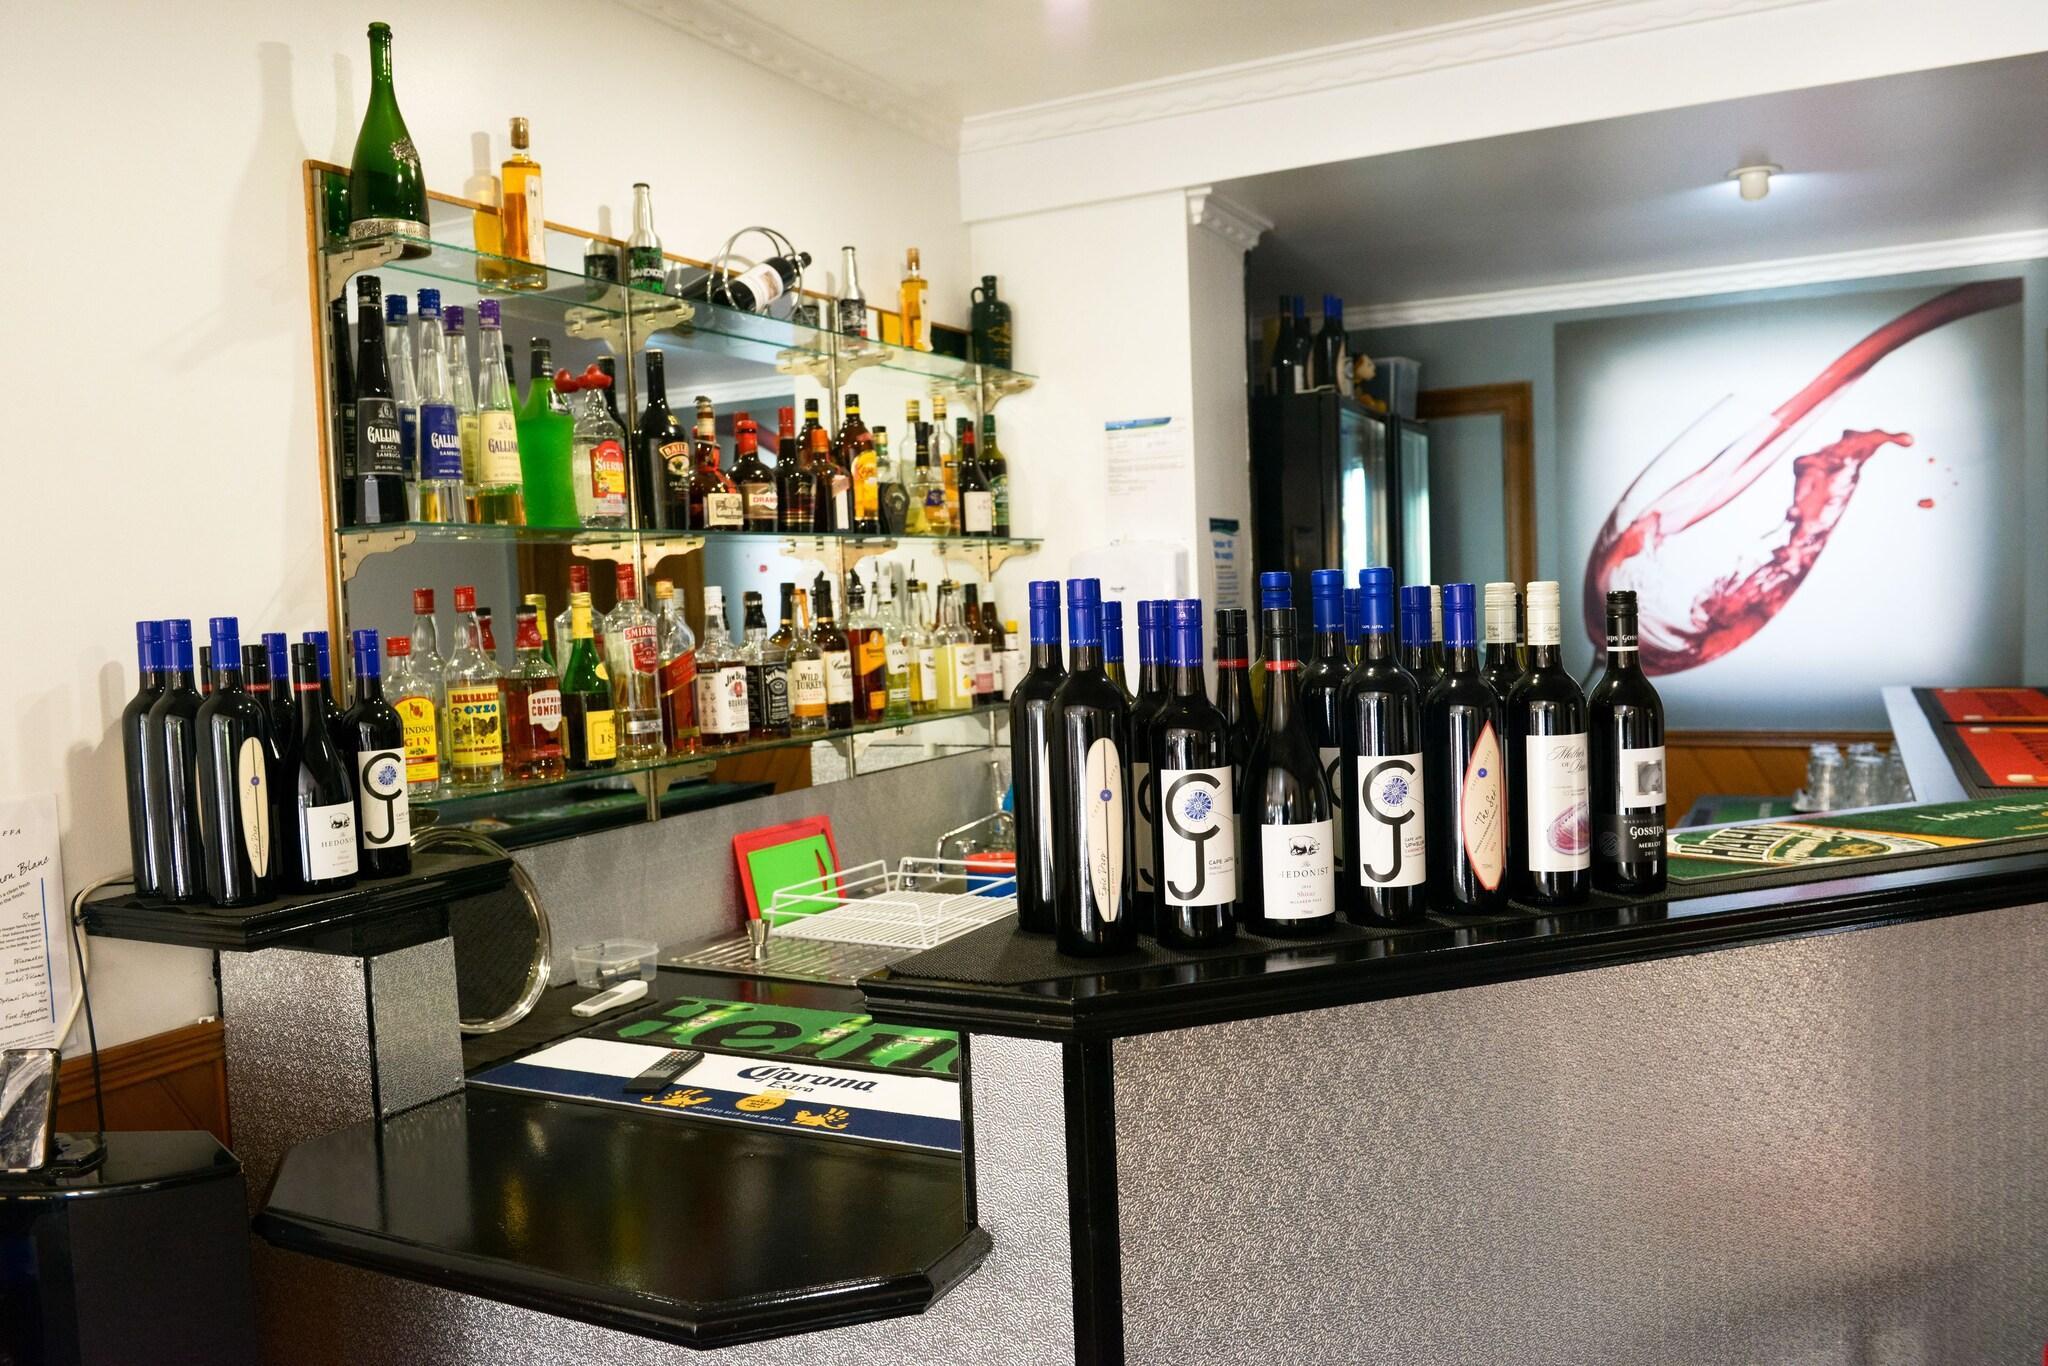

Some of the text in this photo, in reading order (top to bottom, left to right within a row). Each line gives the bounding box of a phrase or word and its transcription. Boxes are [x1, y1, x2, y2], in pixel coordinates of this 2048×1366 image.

[488, 438, 518, 453] GALLIAN
[664, 442, 690, 454] BAILE
[626, 626, 658, 638] SMIRN
[800, 673, 819, 682] WILD
[796, 680, 823, 690] TURKEY
[404, 725, 434, 736] INDSOR
[405, 737, 431, 748] GIN
[1630, 825, 1665, 840] Gossips
[1638, 841, 1661, 849] MERLOT
[737, 1065, 878, 1093] Corona
[767, 1079, 815, 1094] Extra
